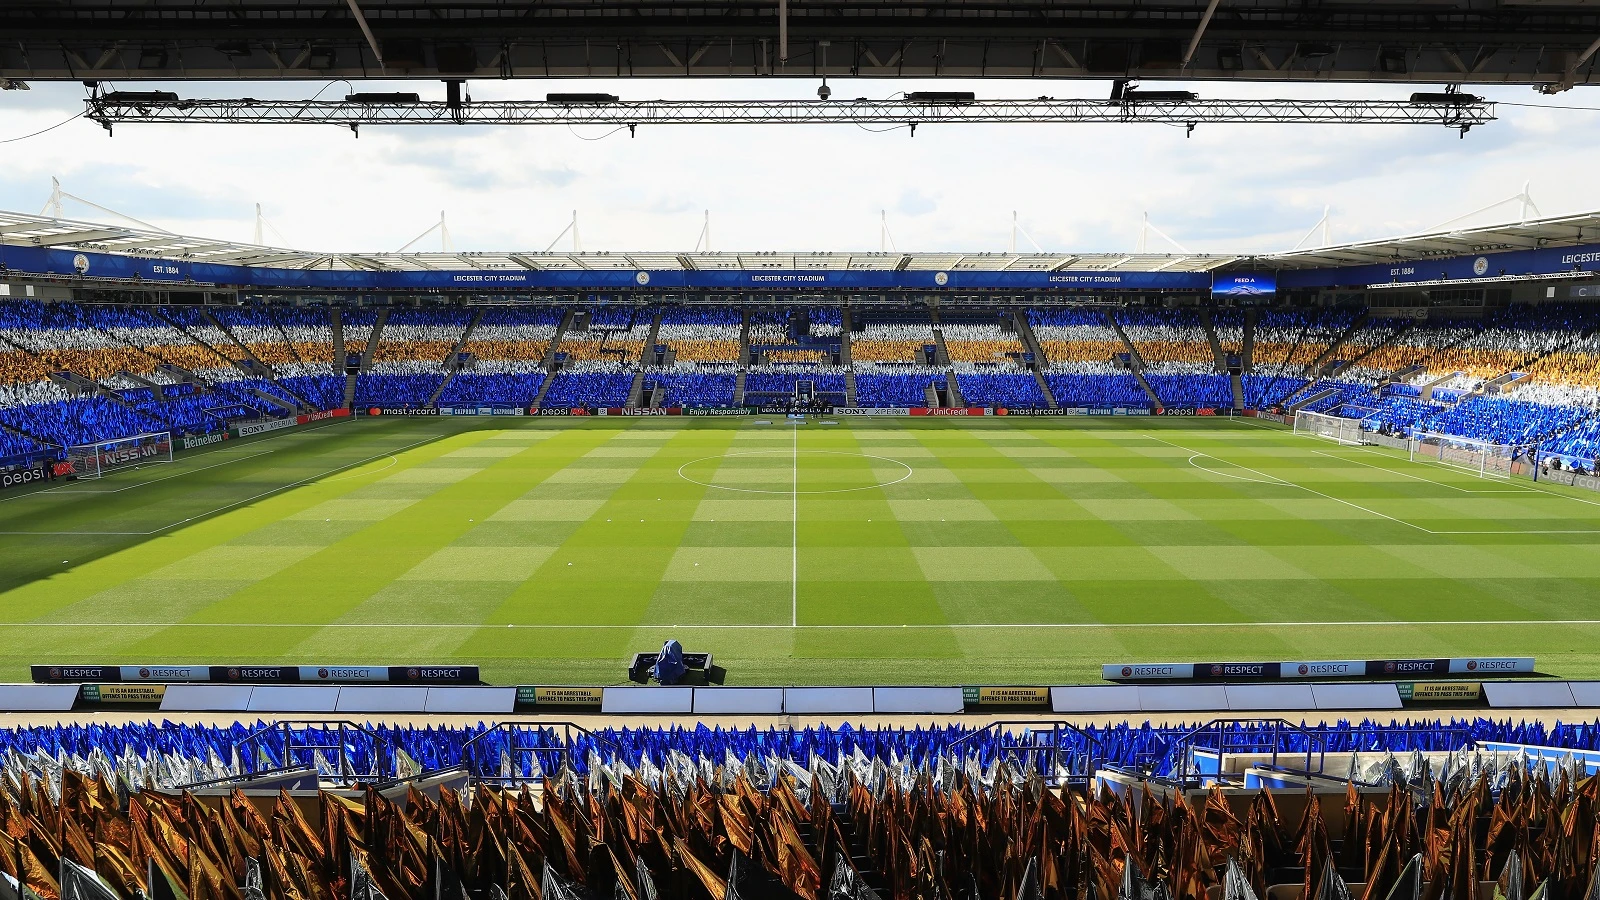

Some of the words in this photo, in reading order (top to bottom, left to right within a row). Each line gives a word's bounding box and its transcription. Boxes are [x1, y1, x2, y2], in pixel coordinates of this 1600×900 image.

[154, 266, 165, 274] EST.
[166, 266, 179, 274] 1884
[1401, 267, 1414, 275] 1884
[311, 410, 333, 421] UniCredit
[541, 407, 568, 416] pepsi
[710, 408, 751, 416] Responsibly
[1168, 408, 1193, 416] pepsi
[1256, 411, 1285, 423] NISSAN
[242, 425, 264, 435] SONY
[269, 419, 292, 429] XPERIA
[183, 431, 222, 449] Heineken
[105, 444, 158, 464] NISSAN
[3, 468, 44, 488] pepsi
[1311, 664, 1348, 672] RESPECT
[1480, 661, 1517, 669] RESPECT
[422, 670, 460, 678] RESPECT
[1134, 667, 1173, 675] RESPECT
[1225, 666, 1263, 674] RESPECT
